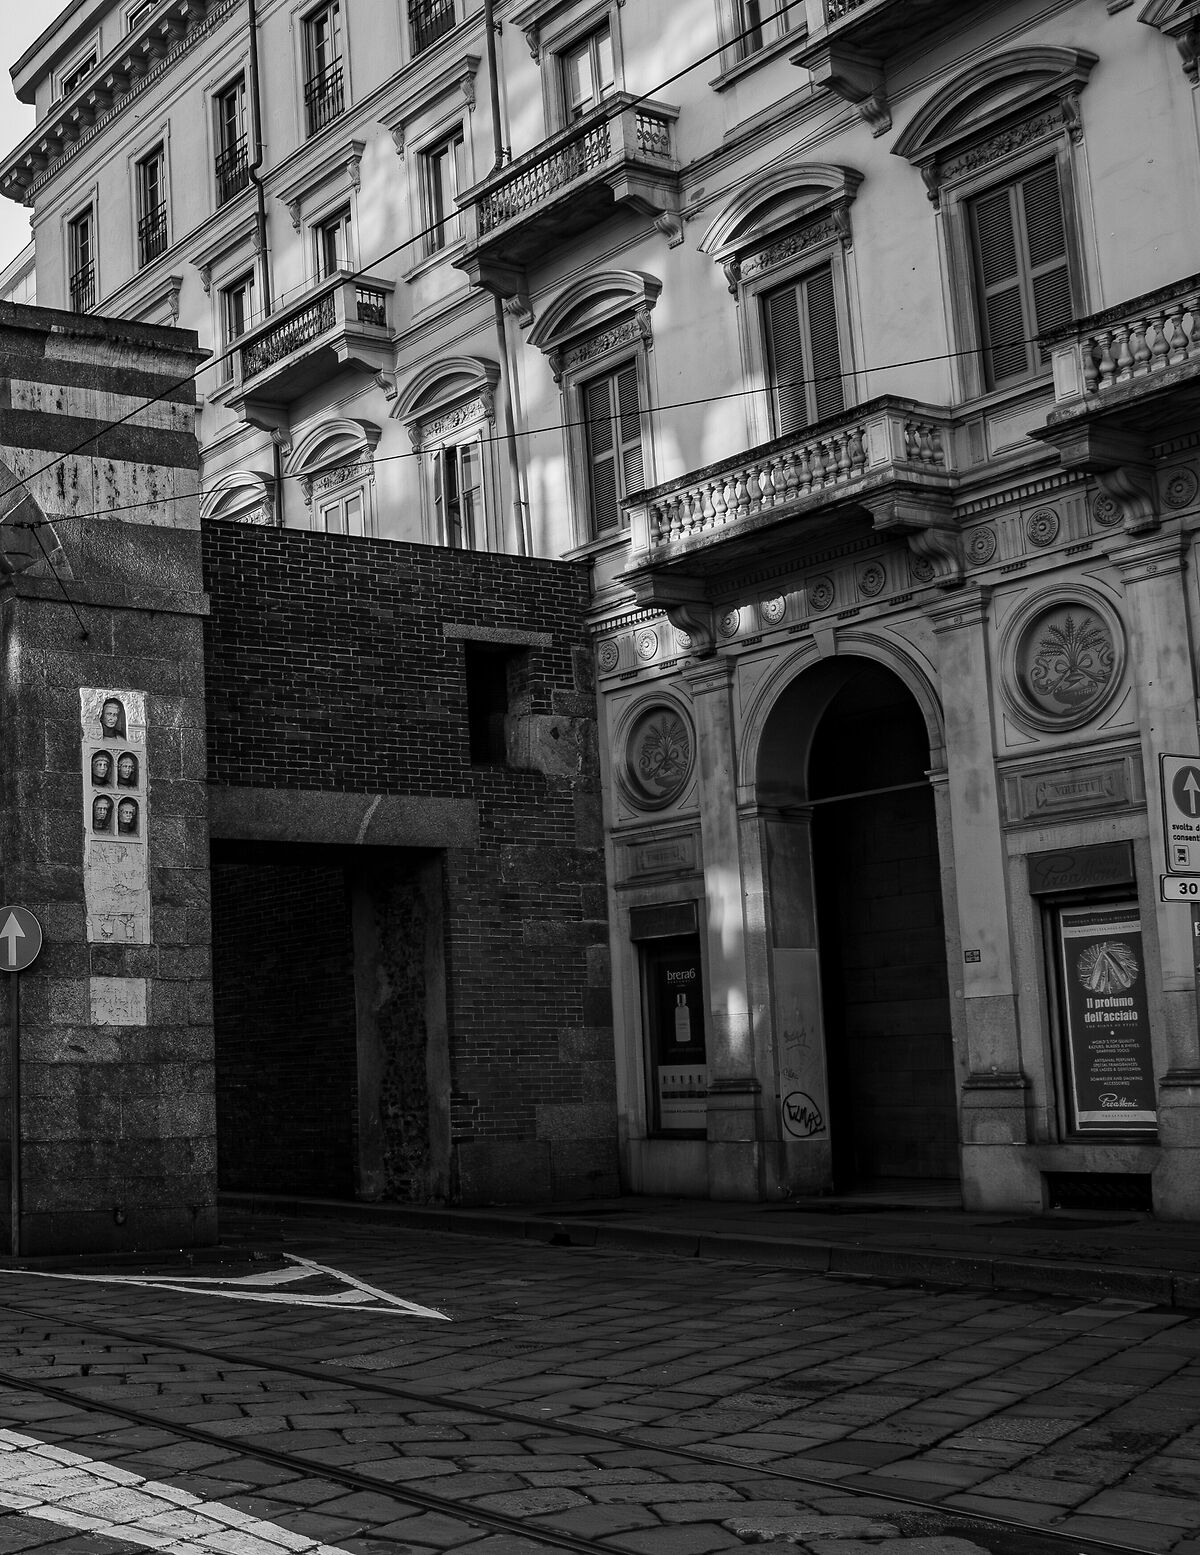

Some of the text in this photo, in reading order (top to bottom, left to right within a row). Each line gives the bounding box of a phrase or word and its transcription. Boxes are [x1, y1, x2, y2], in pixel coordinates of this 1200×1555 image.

[1172, 823, 1193, 831] svolta
[1173, 834, 1200, 842] consent
[1179, 882, 1198, 895] 30
[666, 967, 696, 981] brera6
[1086, 996, 1134, 1009] Il profumo
[1084, 1009, 1138, 1023] dell'acciaio
